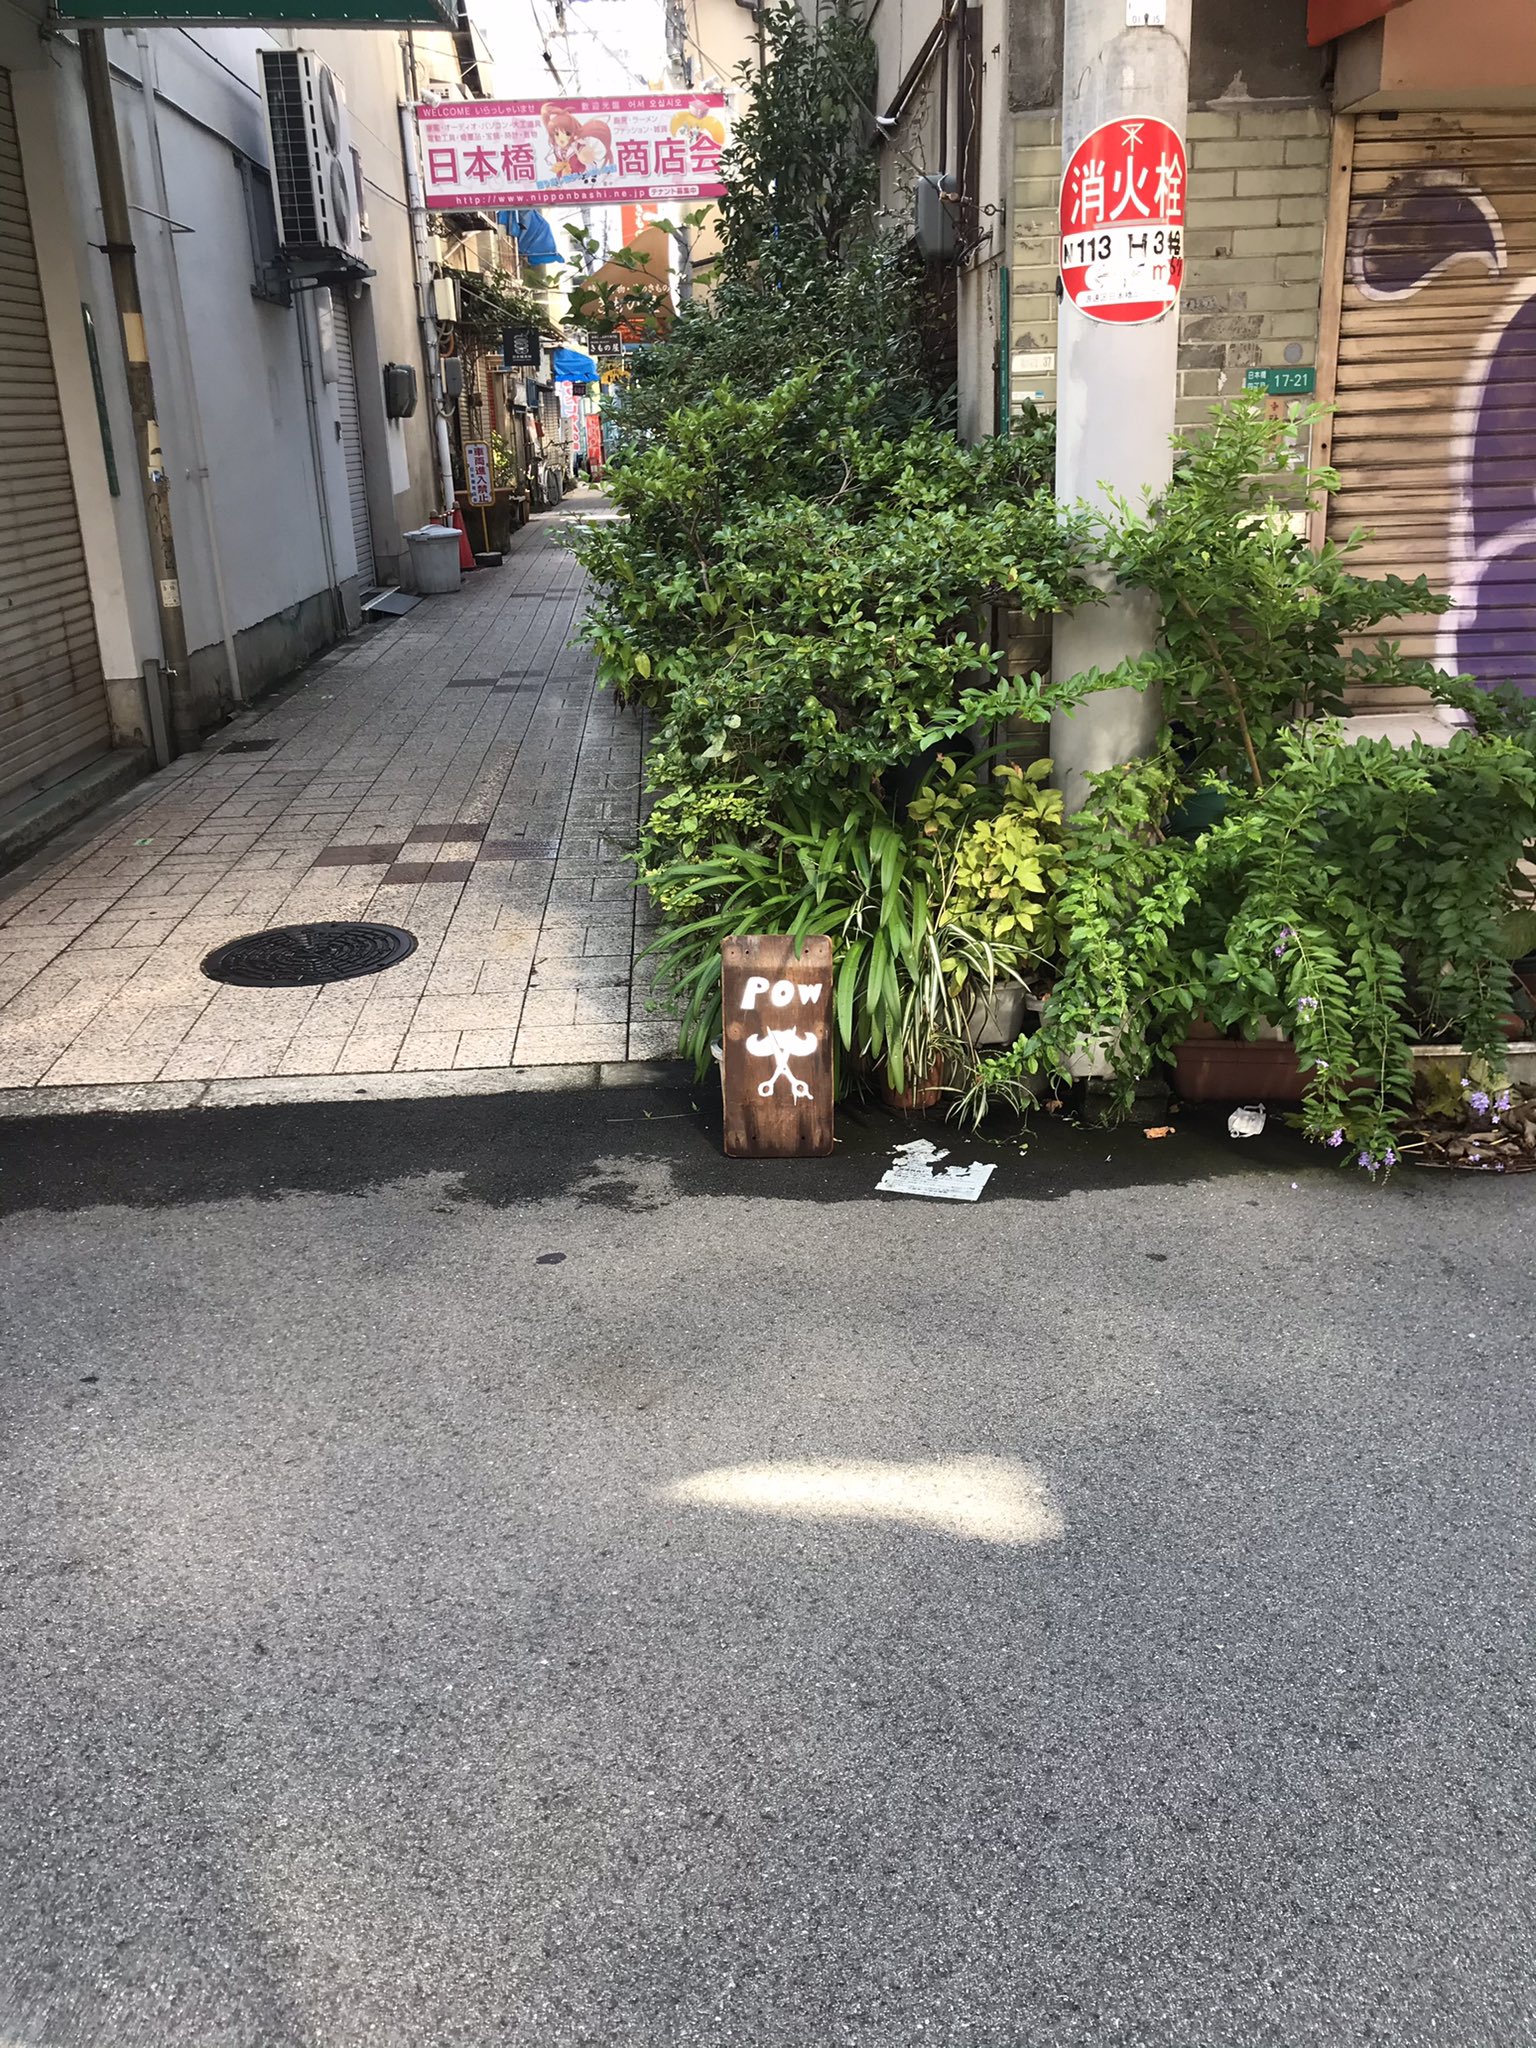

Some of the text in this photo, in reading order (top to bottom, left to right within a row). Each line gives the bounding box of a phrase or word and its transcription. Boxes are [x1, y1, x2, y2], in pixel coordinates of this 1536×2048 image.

[422, 106, 471, 117] WELCOME
[475, 104, 536, 116] いらっしゃいませ
[650, 98, 683, 108] 오십시오
[428, 142, 536, 185] 日本橋
[615, 134, 722, 177] 商店会
[455, 189, 645, 206] http://www.nipponbashi.ne.jp
[1070, 152, 1183, 225] 消火栓
[1274, 373, 1308, 387] 17-21
[473, 447, 489, 503] 車両進入禁止
